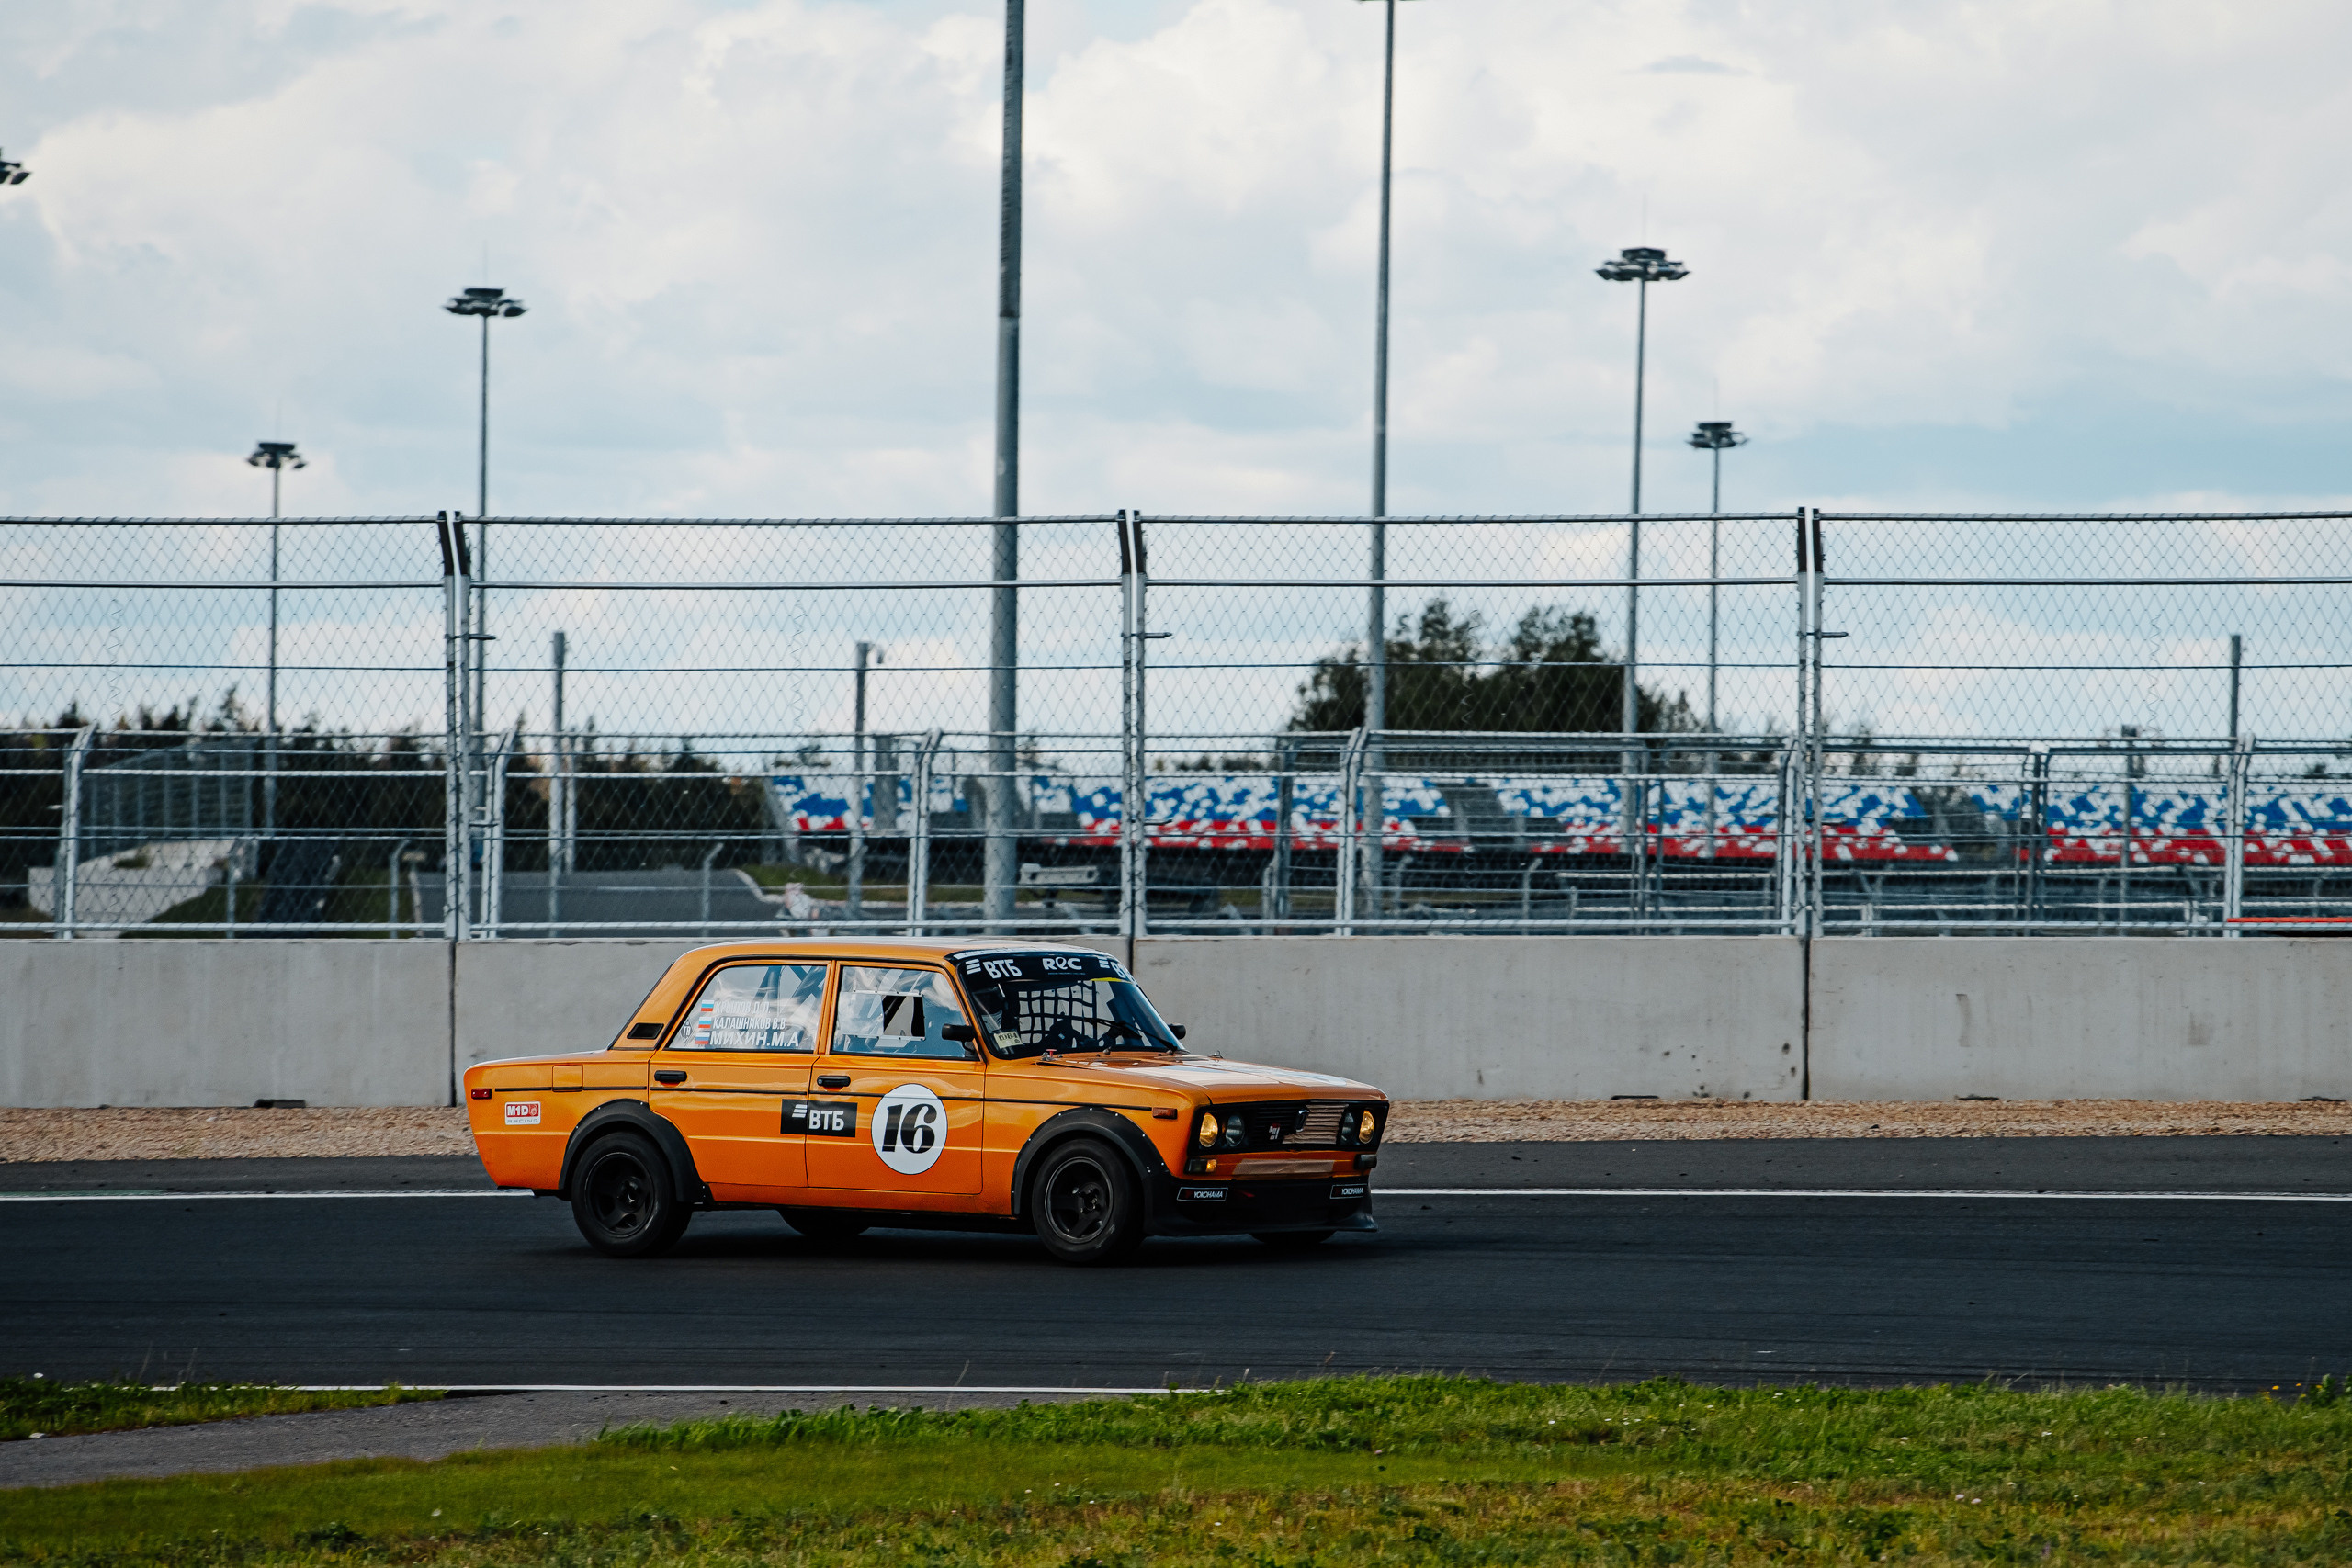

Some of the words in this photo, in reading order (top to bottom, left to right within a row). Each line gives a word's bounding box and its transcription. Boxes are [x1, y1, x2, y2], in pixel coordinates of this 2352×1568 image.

[983, 959, 1022, 978] ВТБ
[713, 1018, 770, 1029] КАЛАШНИКОВ
[507, 1105, 528, 1115] M1D
[809, 1110, 844, 1131] ВТБ
[882, 1104, 937, 1154] 16
